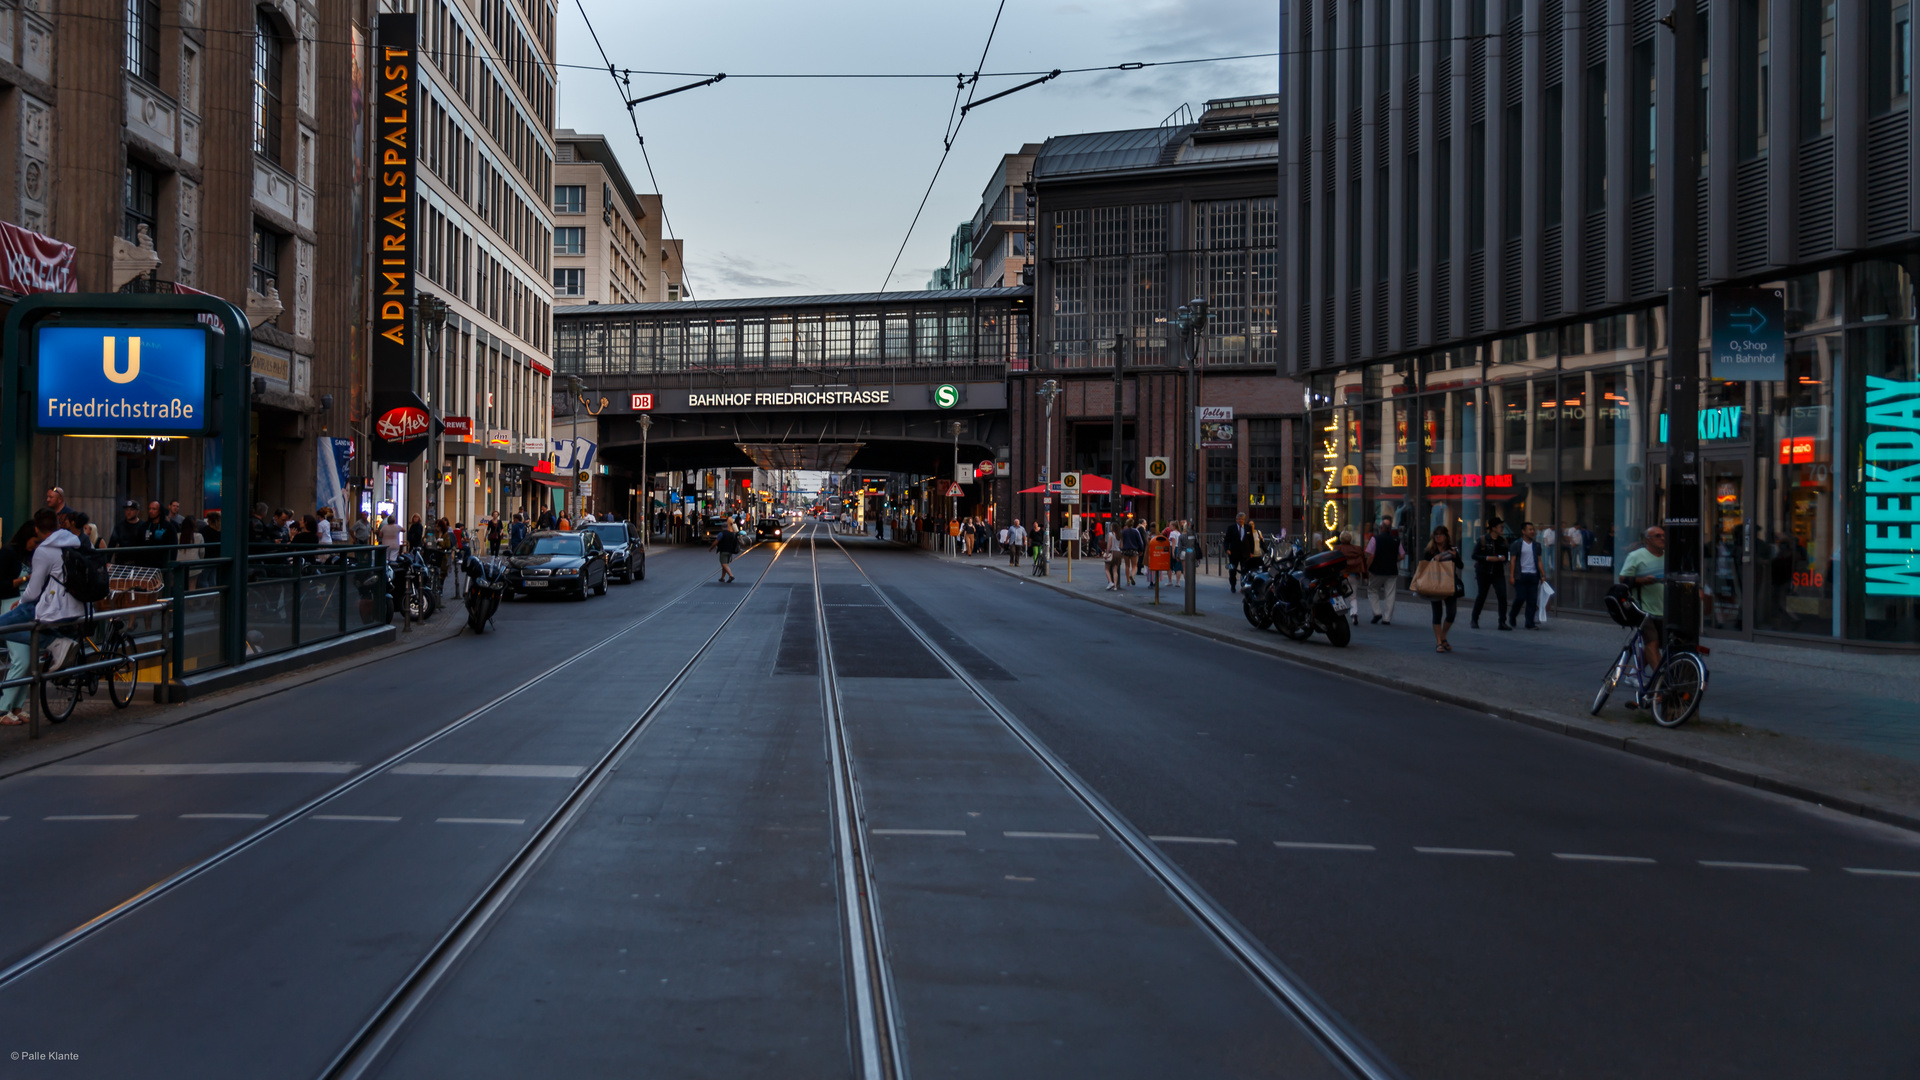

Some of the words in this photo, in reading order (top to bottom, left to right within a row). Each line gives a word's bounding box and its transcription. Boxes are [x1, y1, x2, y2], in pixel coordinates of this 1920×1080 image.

[381, 47, 408, 345] ADMIRALSPALAST
[1743, 341, 1767, 351] Shop
[103, 336, 140, 383] U
[1721, 354, 1732, 363] im
[1736, 354, 1776, 363] Bahnhof
[633, 396, 650, 408] DB
[689, 393, 751, 407] BAHNHOF
[755, 391, 889, 405] FRIEDRICHSTRASSE
[939, 385, 955, 405] S
[48, 398, 193, 418] Friedrichstraße
[1203, 407, 1225, 419] Jolly
[446, 421, 467, 429] REWE
[494, 432, 508, 440] dm
[1866, 375, 1920, 596] WEEKDAY
[1792, 568, 1823, 587] sale
